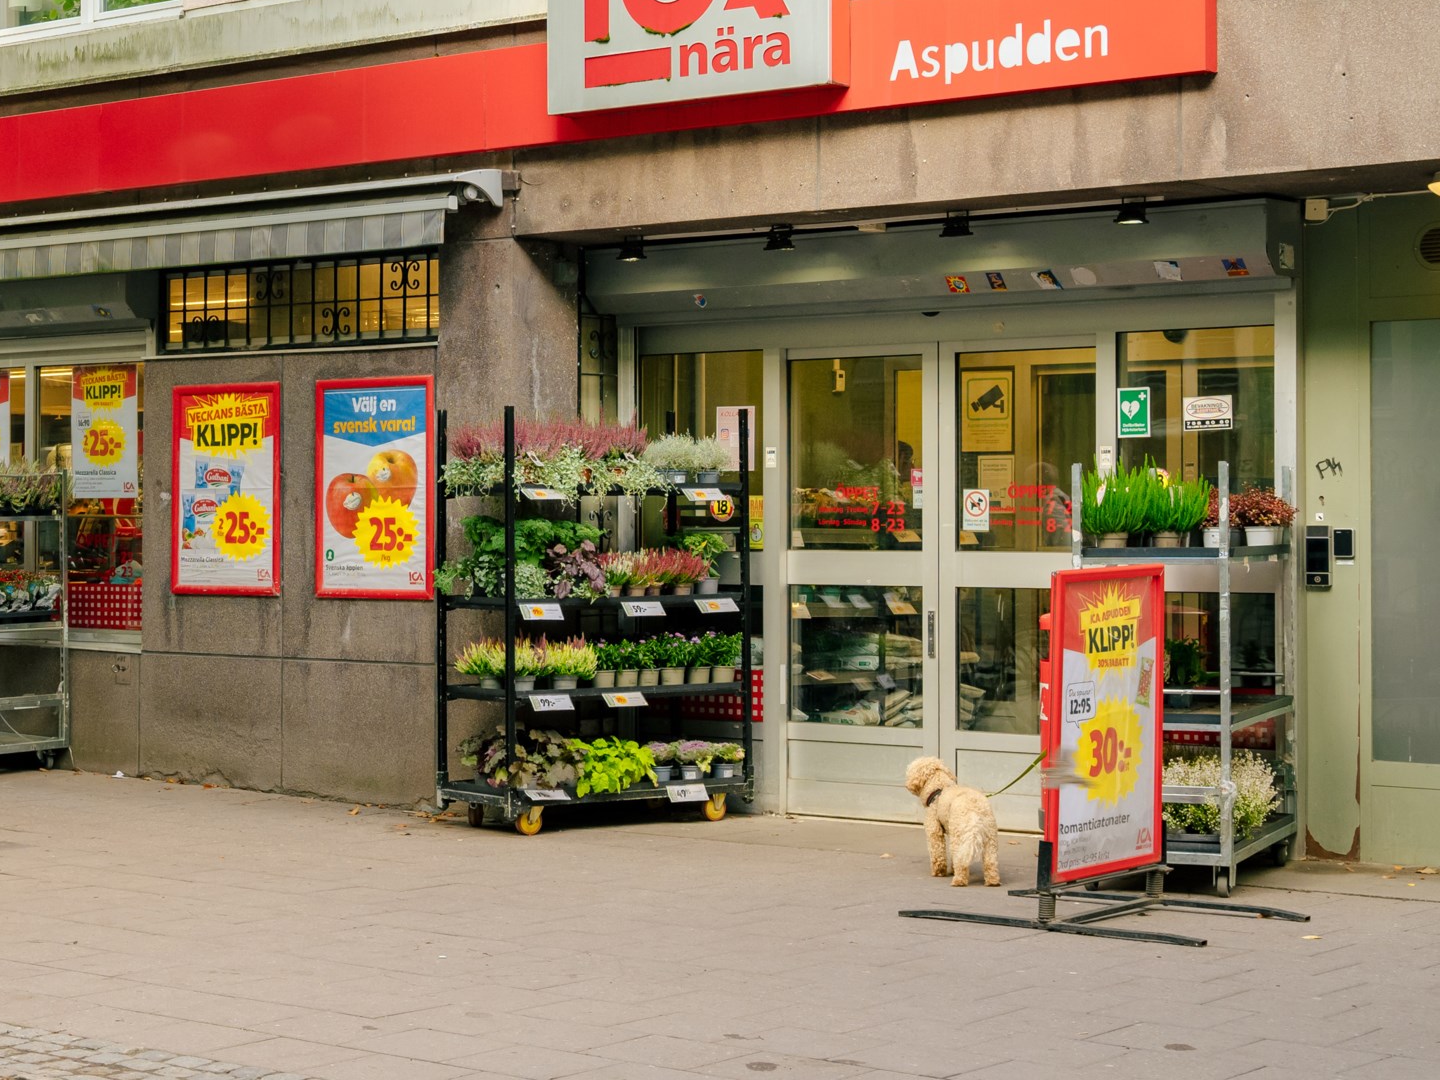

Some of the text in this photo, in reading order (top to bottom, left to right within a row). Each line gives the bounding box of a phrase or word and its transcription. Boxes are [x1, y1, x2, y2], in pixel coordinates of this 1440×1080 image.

[679, 26, 791, 78] nära
[890, 18, 1109, 84] Aspudden
[85, 385, 121, 400] KLIPP!
[189, 403, 265, 423] VECKANS BÄSTA
[352, 397, 396, 415] Välj en
[333, 416, 416, 434] svensk vara!
[89, 429, 122, 456] 25:-
[196, 422, 258, 447] KLIPP!
[123, 482, 134, 490] ICA
[835, 483, 880, 500] ÖPPET
[1007, 482, 1056, 499] ÖPPET
[716, 500, 728, 515] 18
[871, 501, 905, 516] 7-23
[1046, 500, 1072, 515] 7-2
[219, 511, 265, 545] 2 25:-
[871, 518, 905, 532] 8-23
[1046, 518, 1072, 533] 8-2
[369, 517, 413, 552] 25:-
[257, 569, 270, 579] ICA
[409, 572, 424, 582] ICA
[1089, 624, 1134, 654] KLIPP!
[1070, 698, 1092, 715] 12:95
[1089, 727, 1131, 777] 30:-
[1136, 827, 1152, 845] ICA
